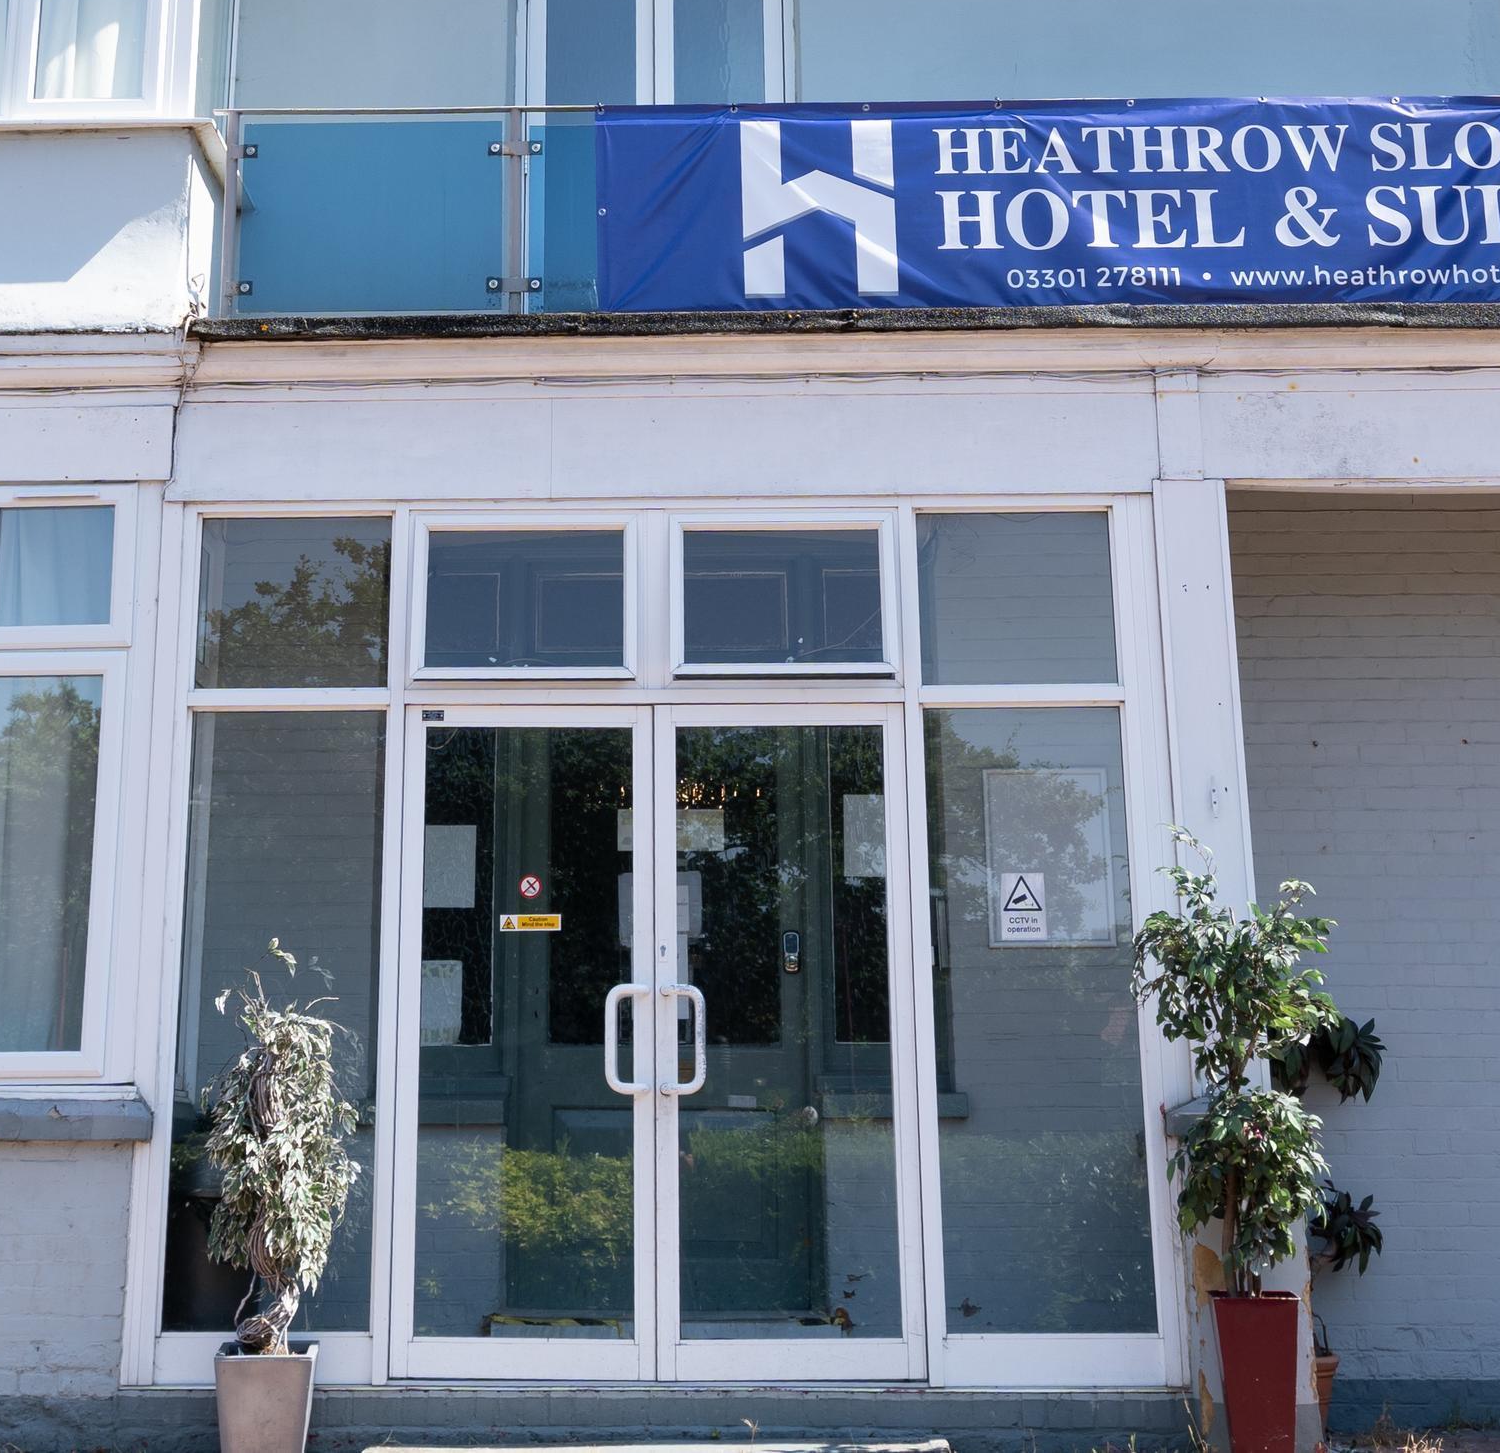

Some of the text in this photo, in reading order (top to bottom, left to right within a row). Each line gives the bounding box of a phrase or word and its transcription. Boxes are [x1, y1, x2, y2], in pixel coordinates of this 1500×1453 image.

[932, 124, 1349, 175] HEATHROW
[934, 188, 1246, 251] HOTEL
[1274, 186, 1341, 247] &
[1006, 268, 1087, 289] 03301
[1097, 266, 1182, 287] 278111
[1007, 926, 1041, 934] operation
[1009, 916, 1038, 924] CCTV in
